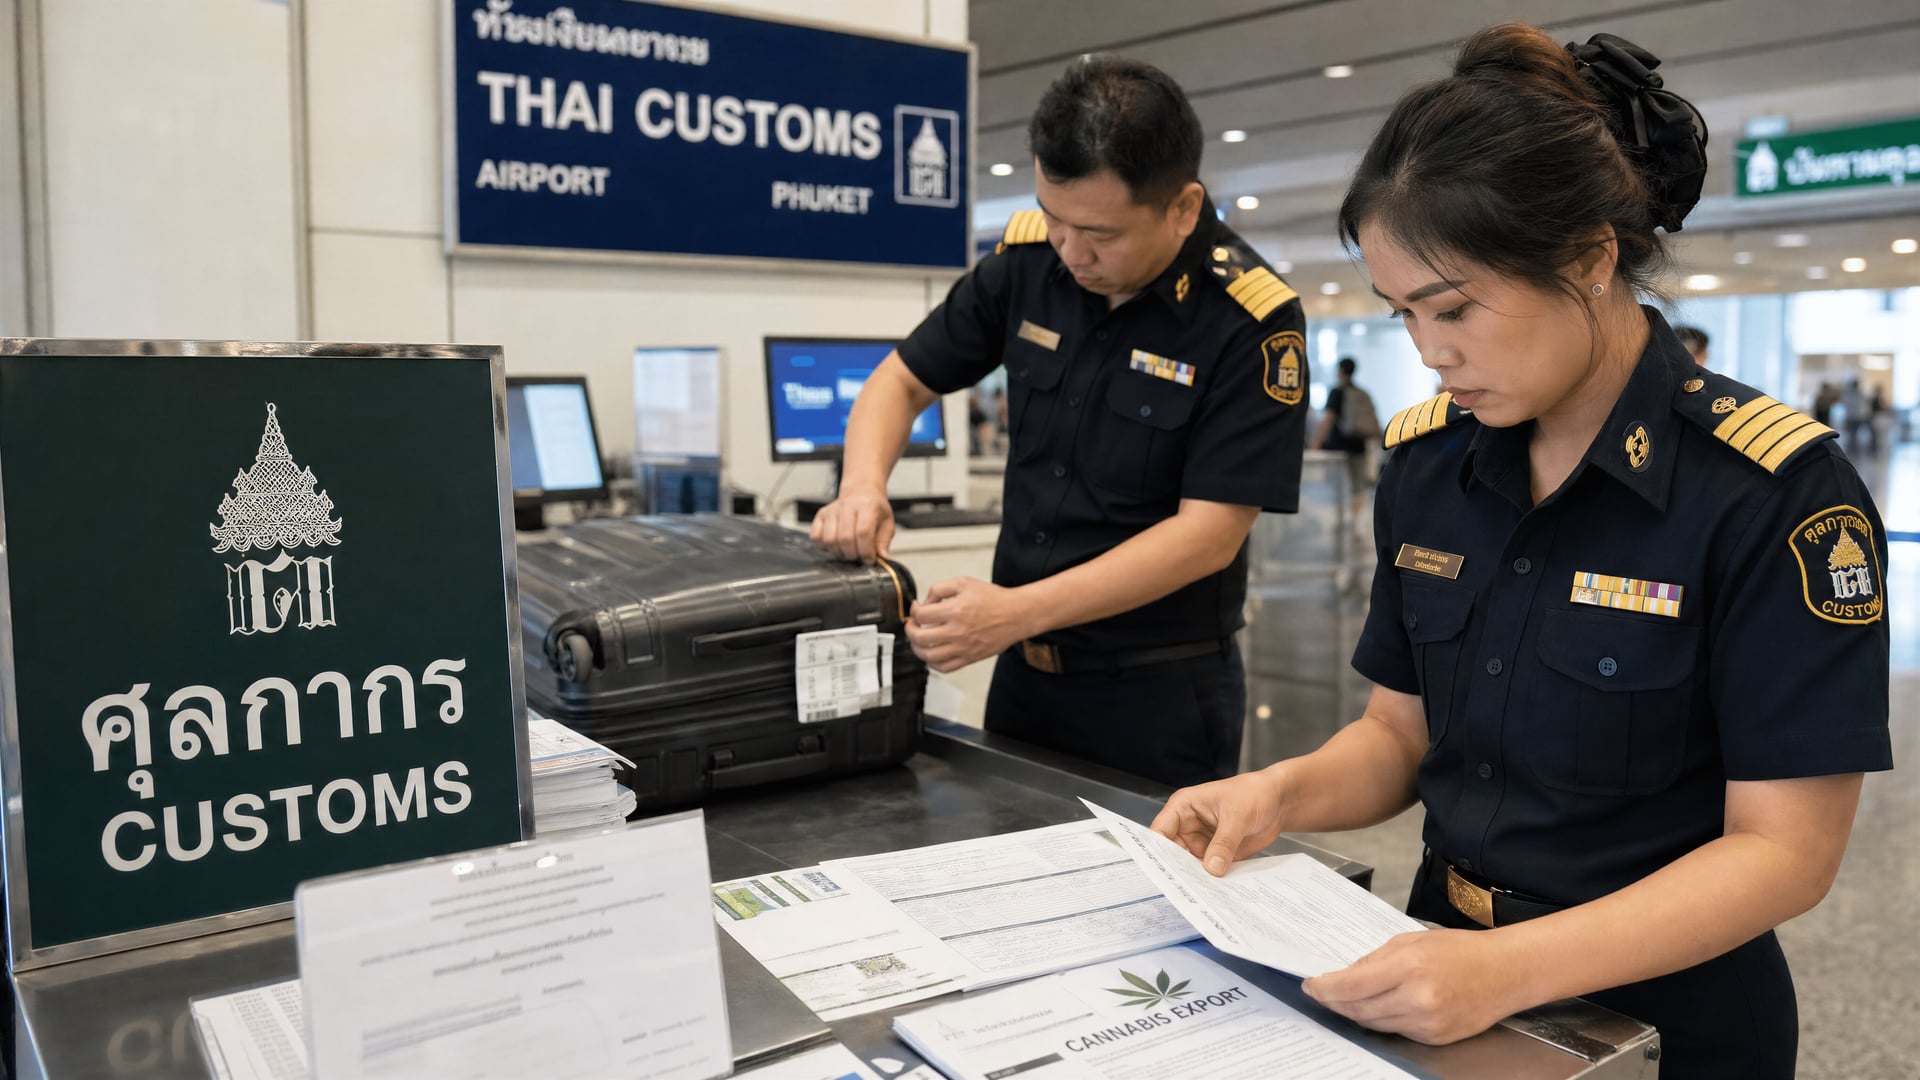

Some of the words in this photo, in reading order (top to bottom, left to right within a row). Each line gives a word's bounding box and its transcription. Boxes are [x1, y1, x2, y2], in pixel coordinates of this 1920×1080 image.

[477, 71, 613, 133] THAI
[635, 88, 882, 160] CUSTOMS
[476, 159, 610, 196] AIRPORT
[772, 181, 873, 214] PHUKET
[82, 658, 467, 799] ศุลกากร
[101, 760, 472, 872] CUSTOMS
[1065, 1012, 1172, 1053] CANNABIS
[1170, 986, 1248, 1019] EXPORT
